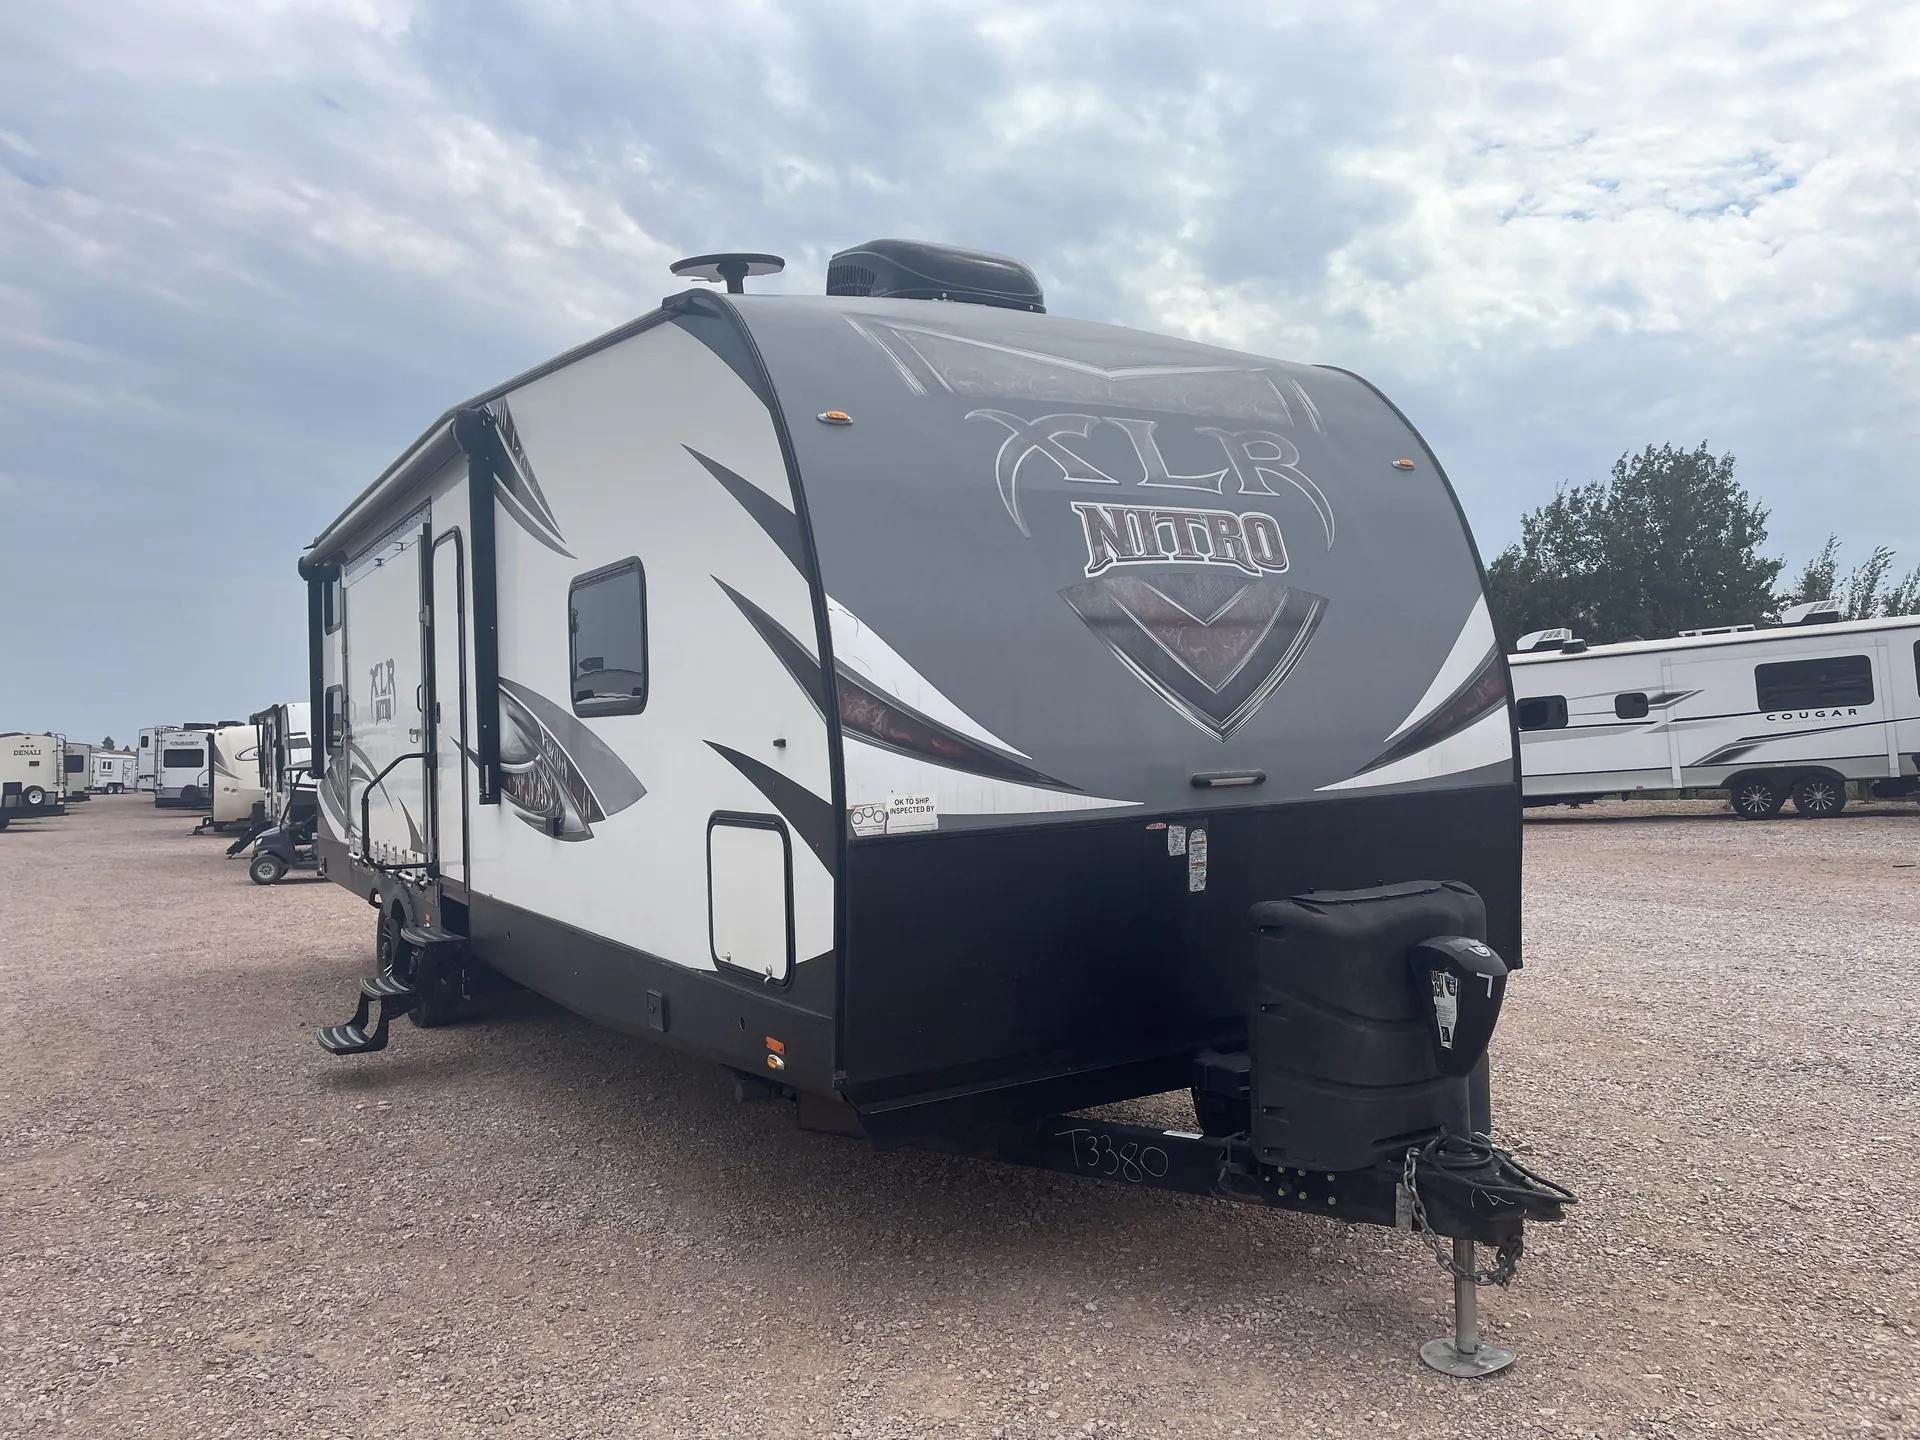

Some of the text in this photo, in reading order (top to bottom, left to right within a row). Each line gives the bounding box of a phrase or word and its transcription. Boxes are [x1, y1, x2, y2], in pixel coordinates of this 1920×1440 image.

[965, 408, 1335, 552] XLR
[1070, 501, 1290, 578] NITRO
[369, 657, 397, 720] XLR
[1766, 708, 1857, 721] COUGAR
[890, 806, 925, 814] INSPECTED
[1054, 1128, 1169, 1183] T3380
